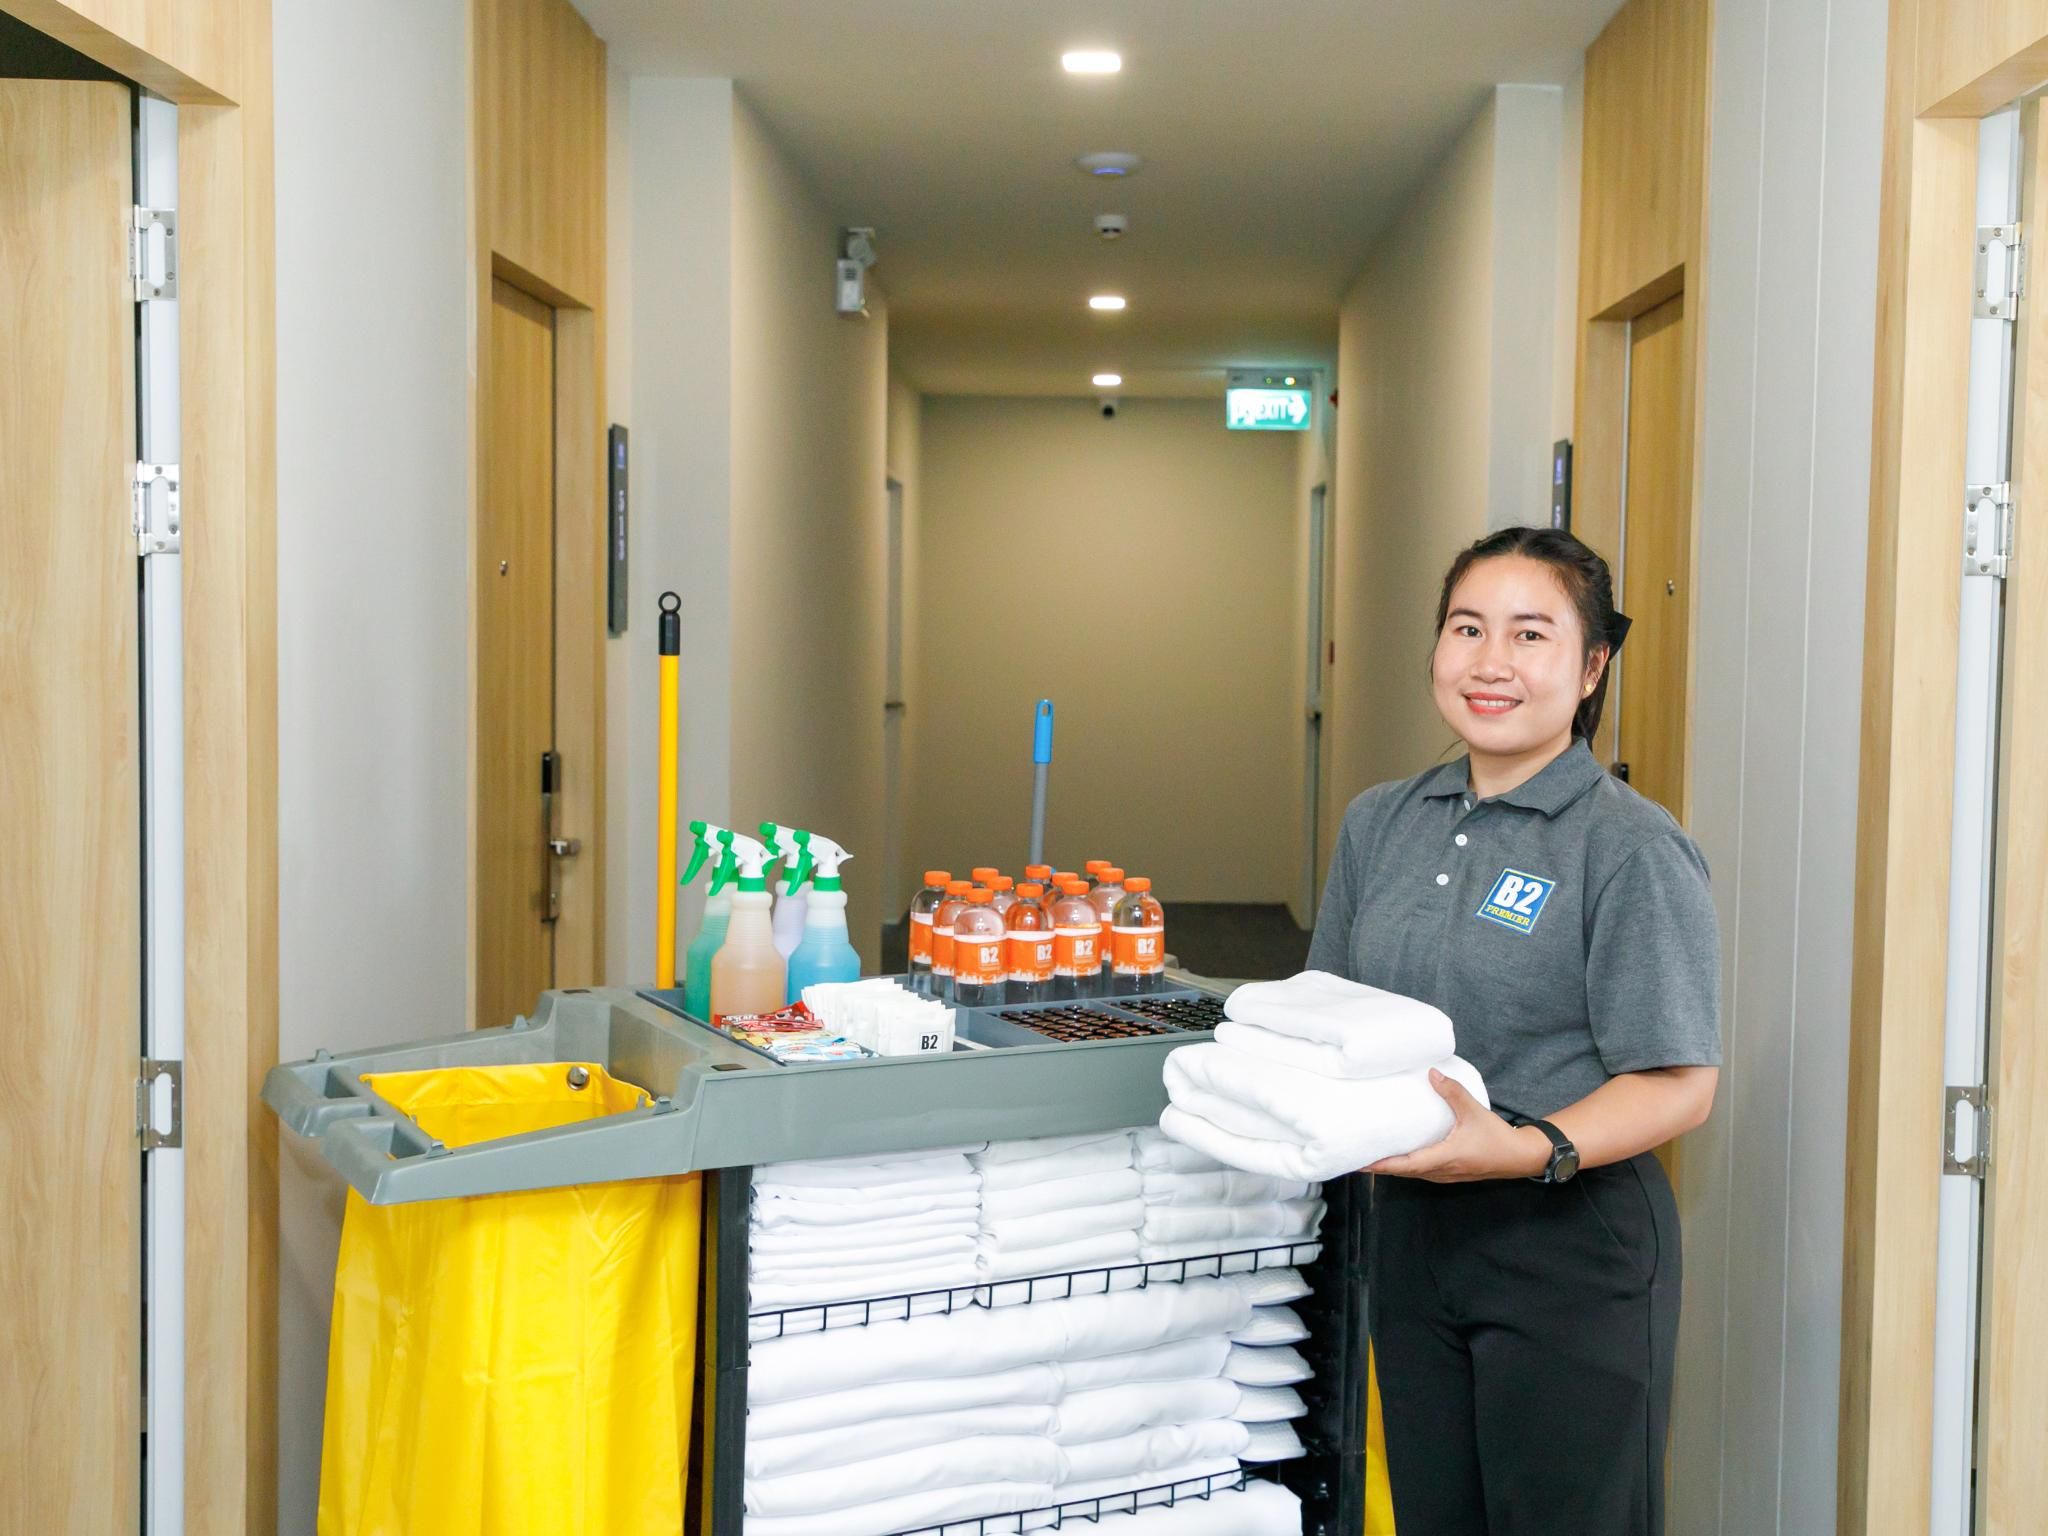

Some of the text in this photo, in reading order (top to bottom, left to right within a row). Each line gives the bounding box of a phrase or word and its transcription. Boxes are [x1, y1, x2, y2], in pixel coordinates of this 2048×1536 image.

[1493, 875, 1543, 915] B2
[1036, 944, 1053, 961] B2
[1074, 939, 1093, 956] B2
[1138, 938, 1156, 954] B2
[979, 947, 999, 964] B2
[921, 1035, 938, 1050] B2
